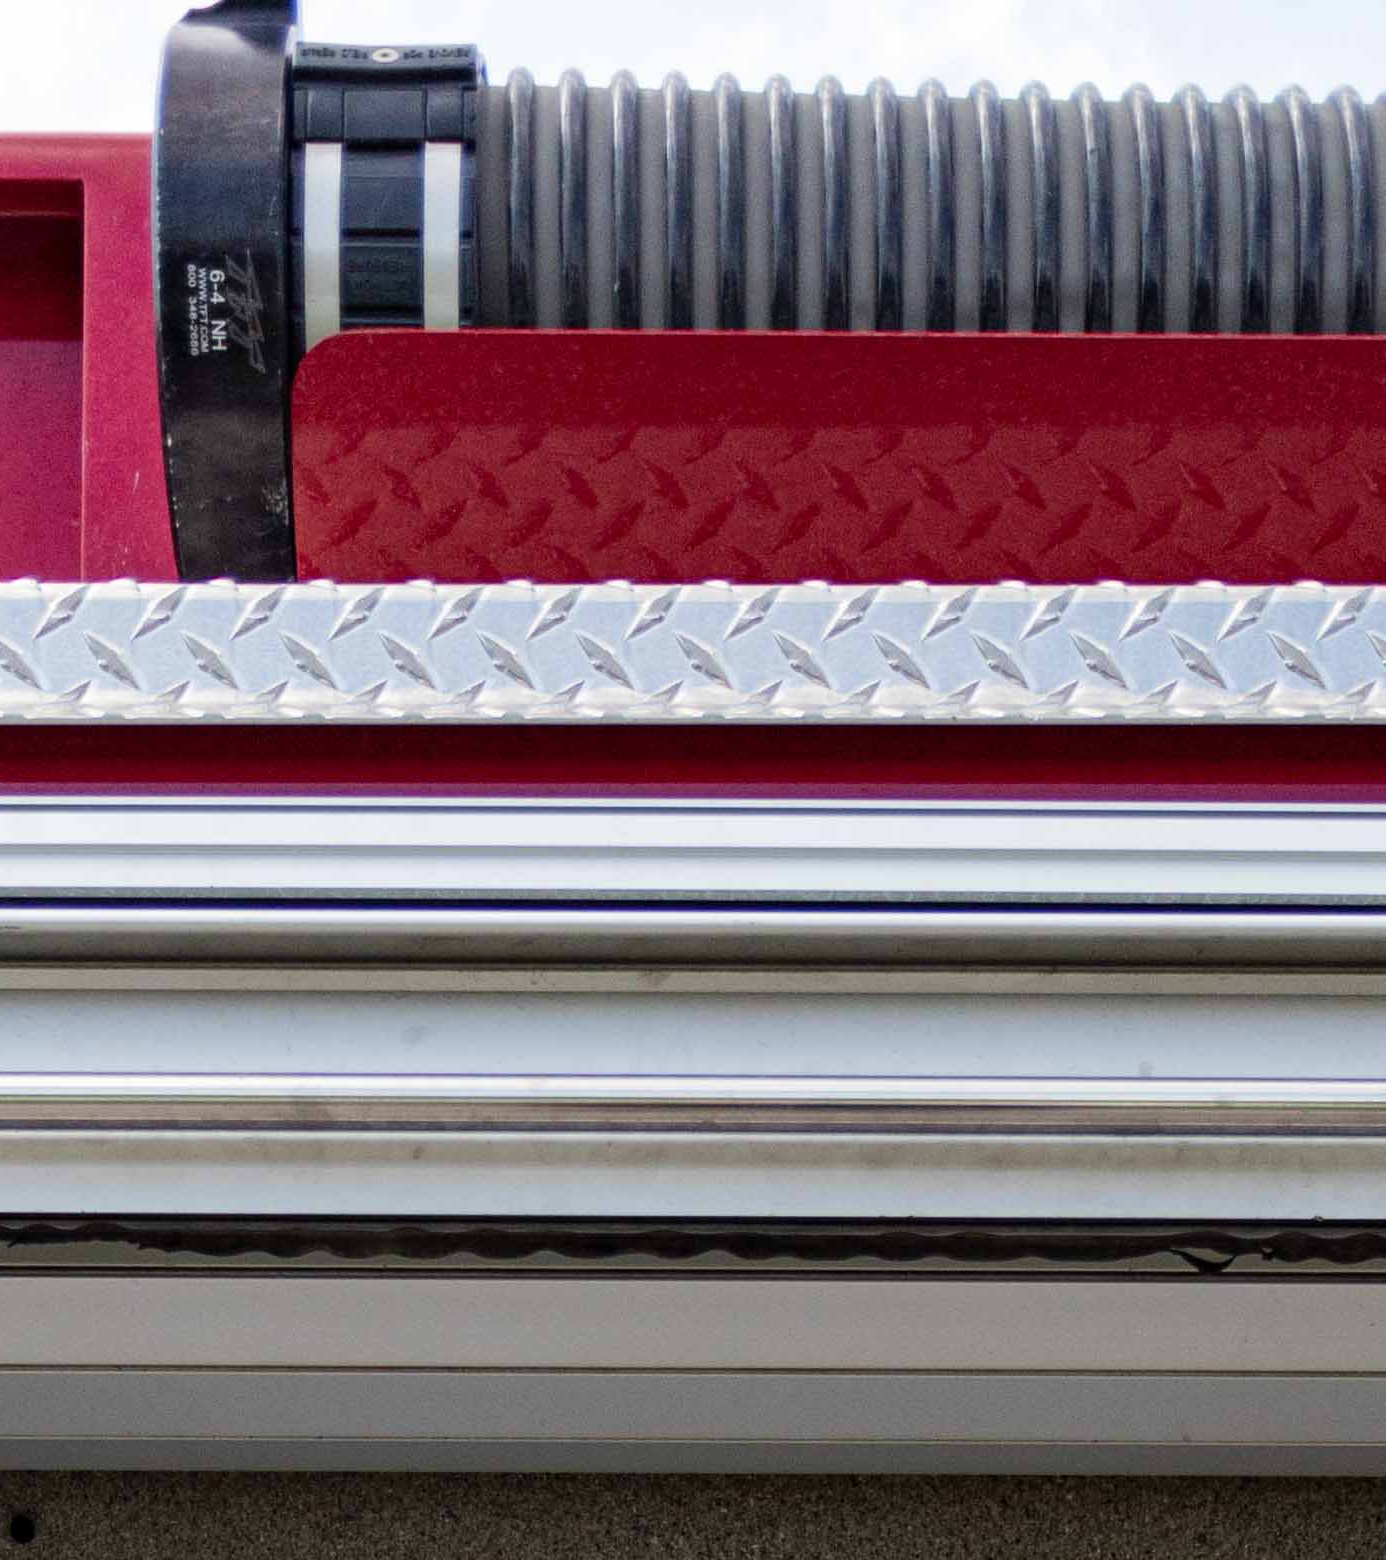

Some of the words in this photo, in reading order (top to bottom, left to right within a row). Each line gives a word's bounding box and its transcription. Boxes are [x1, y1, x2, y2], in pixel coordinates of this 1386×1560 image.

[187, 264, 197, 287] 800
[210, 269, 225, 304] 6-4
[198, 267, 209, 353] WWW.TFT.COM
[211, 320, 227, 351] NH
